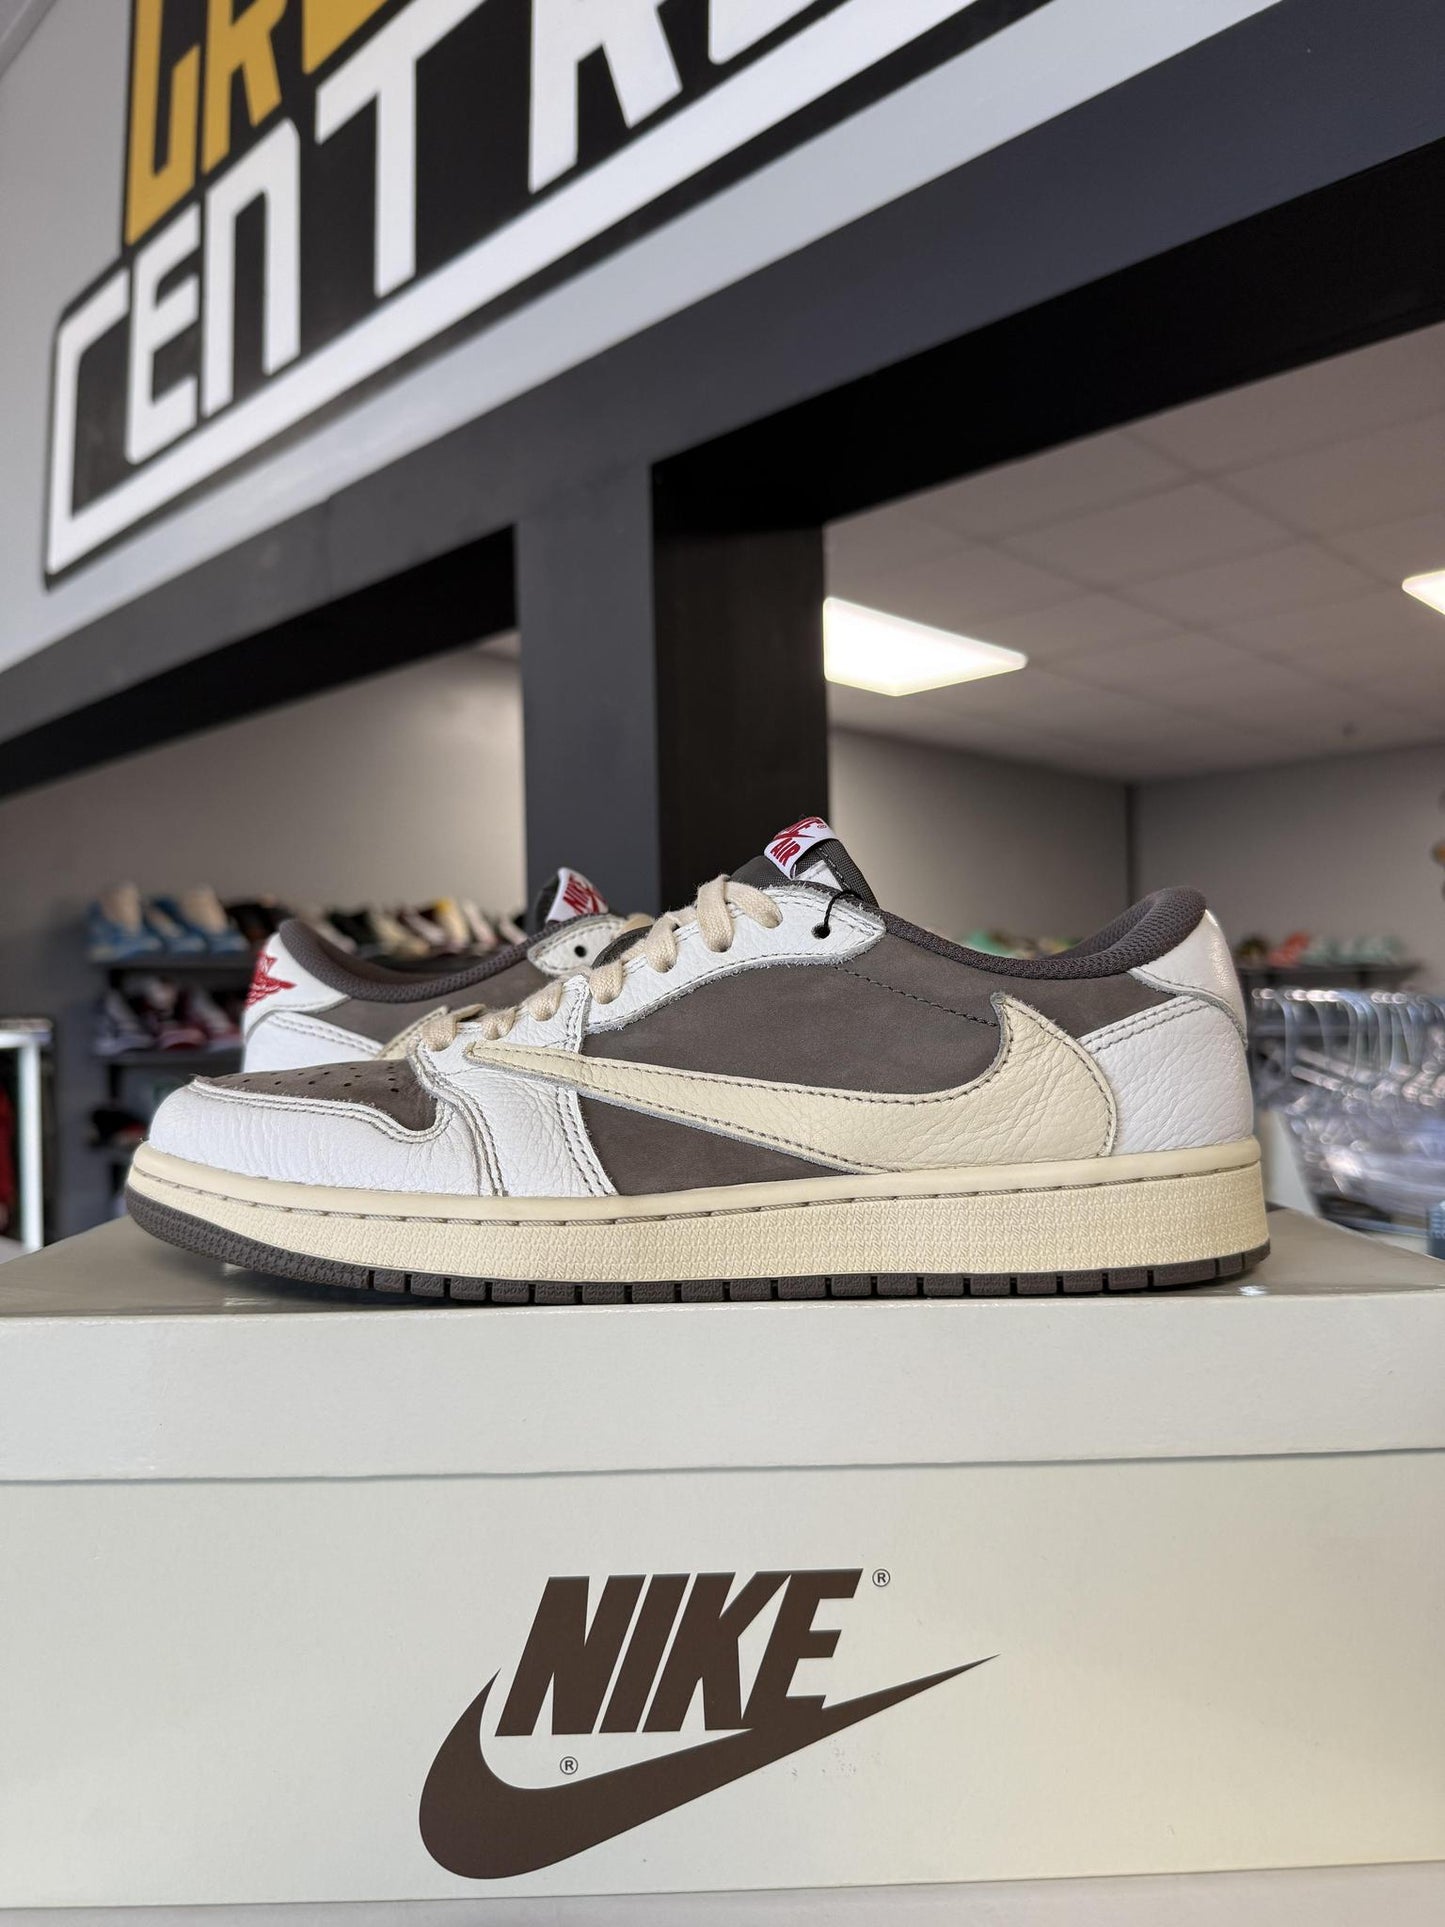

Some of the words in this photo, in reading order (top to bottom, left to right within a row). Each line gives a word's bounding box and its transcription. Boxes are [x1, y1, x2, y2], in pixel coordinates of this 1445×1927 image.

[126, 0, 390, 246] CR
[47, 0, 825, 575] CENTR
[769, 838, 801, 868] AIR
[494, 1567, 864, 1737] NIKE
